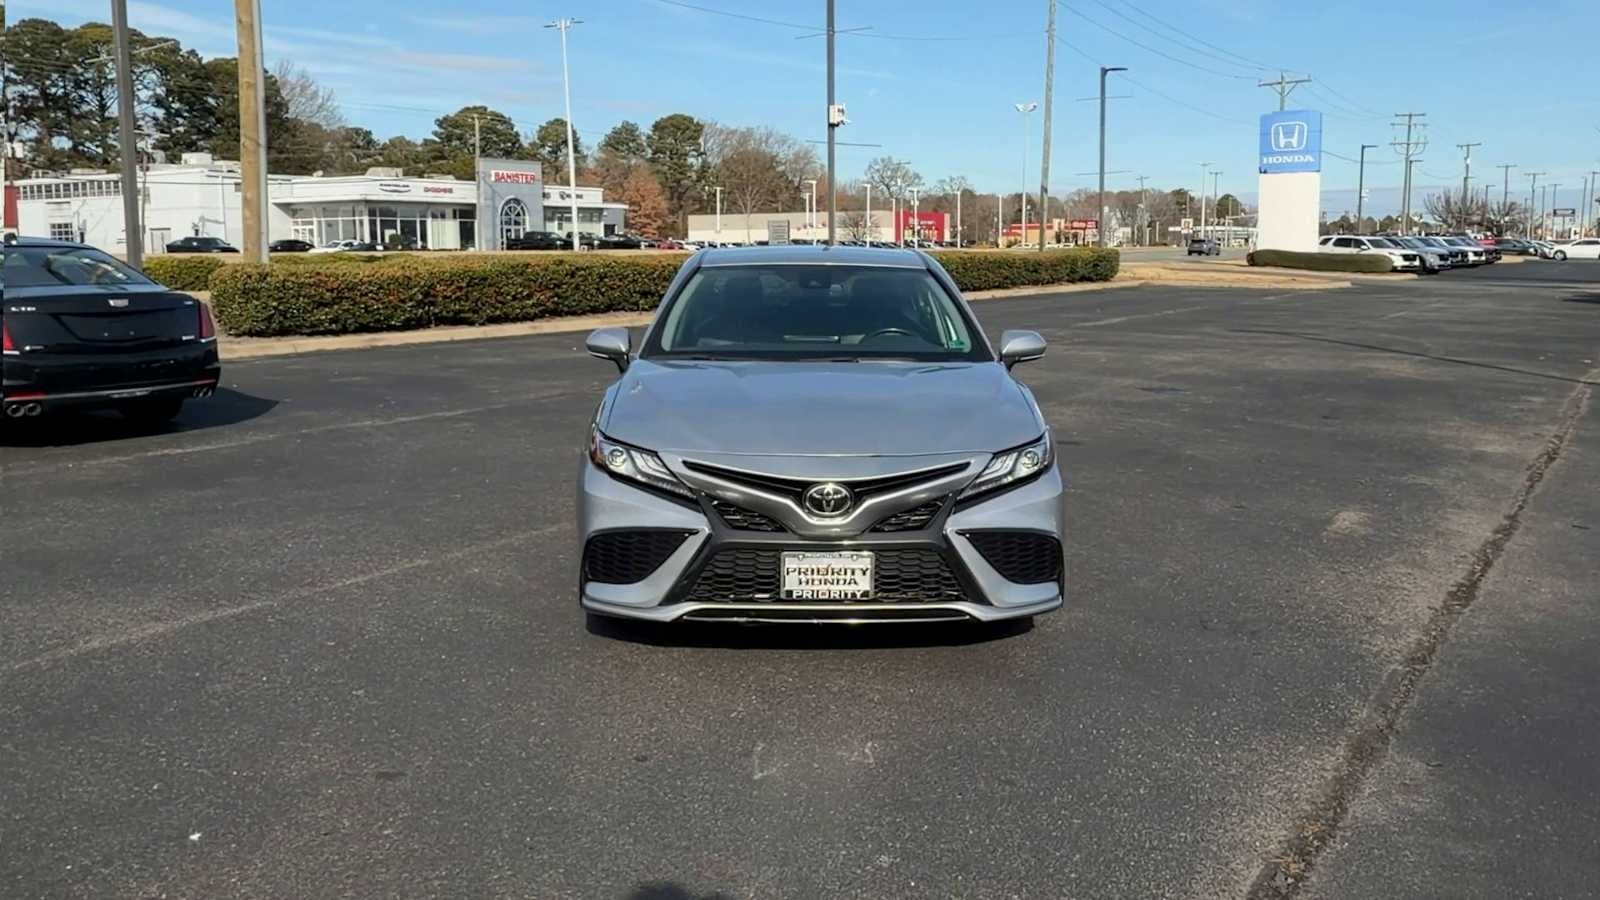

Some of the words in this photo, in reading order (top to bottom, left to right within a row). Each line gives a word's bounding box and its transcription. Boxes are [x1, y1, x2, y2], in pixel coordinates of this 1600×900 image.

[1263, 155, 1315, 164] HONDA
[494, 171, 536, 184] BANISTER
[785, 566, 869, 576] PRIORITY
[799, 578, 858, 586] HONDA
[792, 590, 864, 600] PRIORITY
